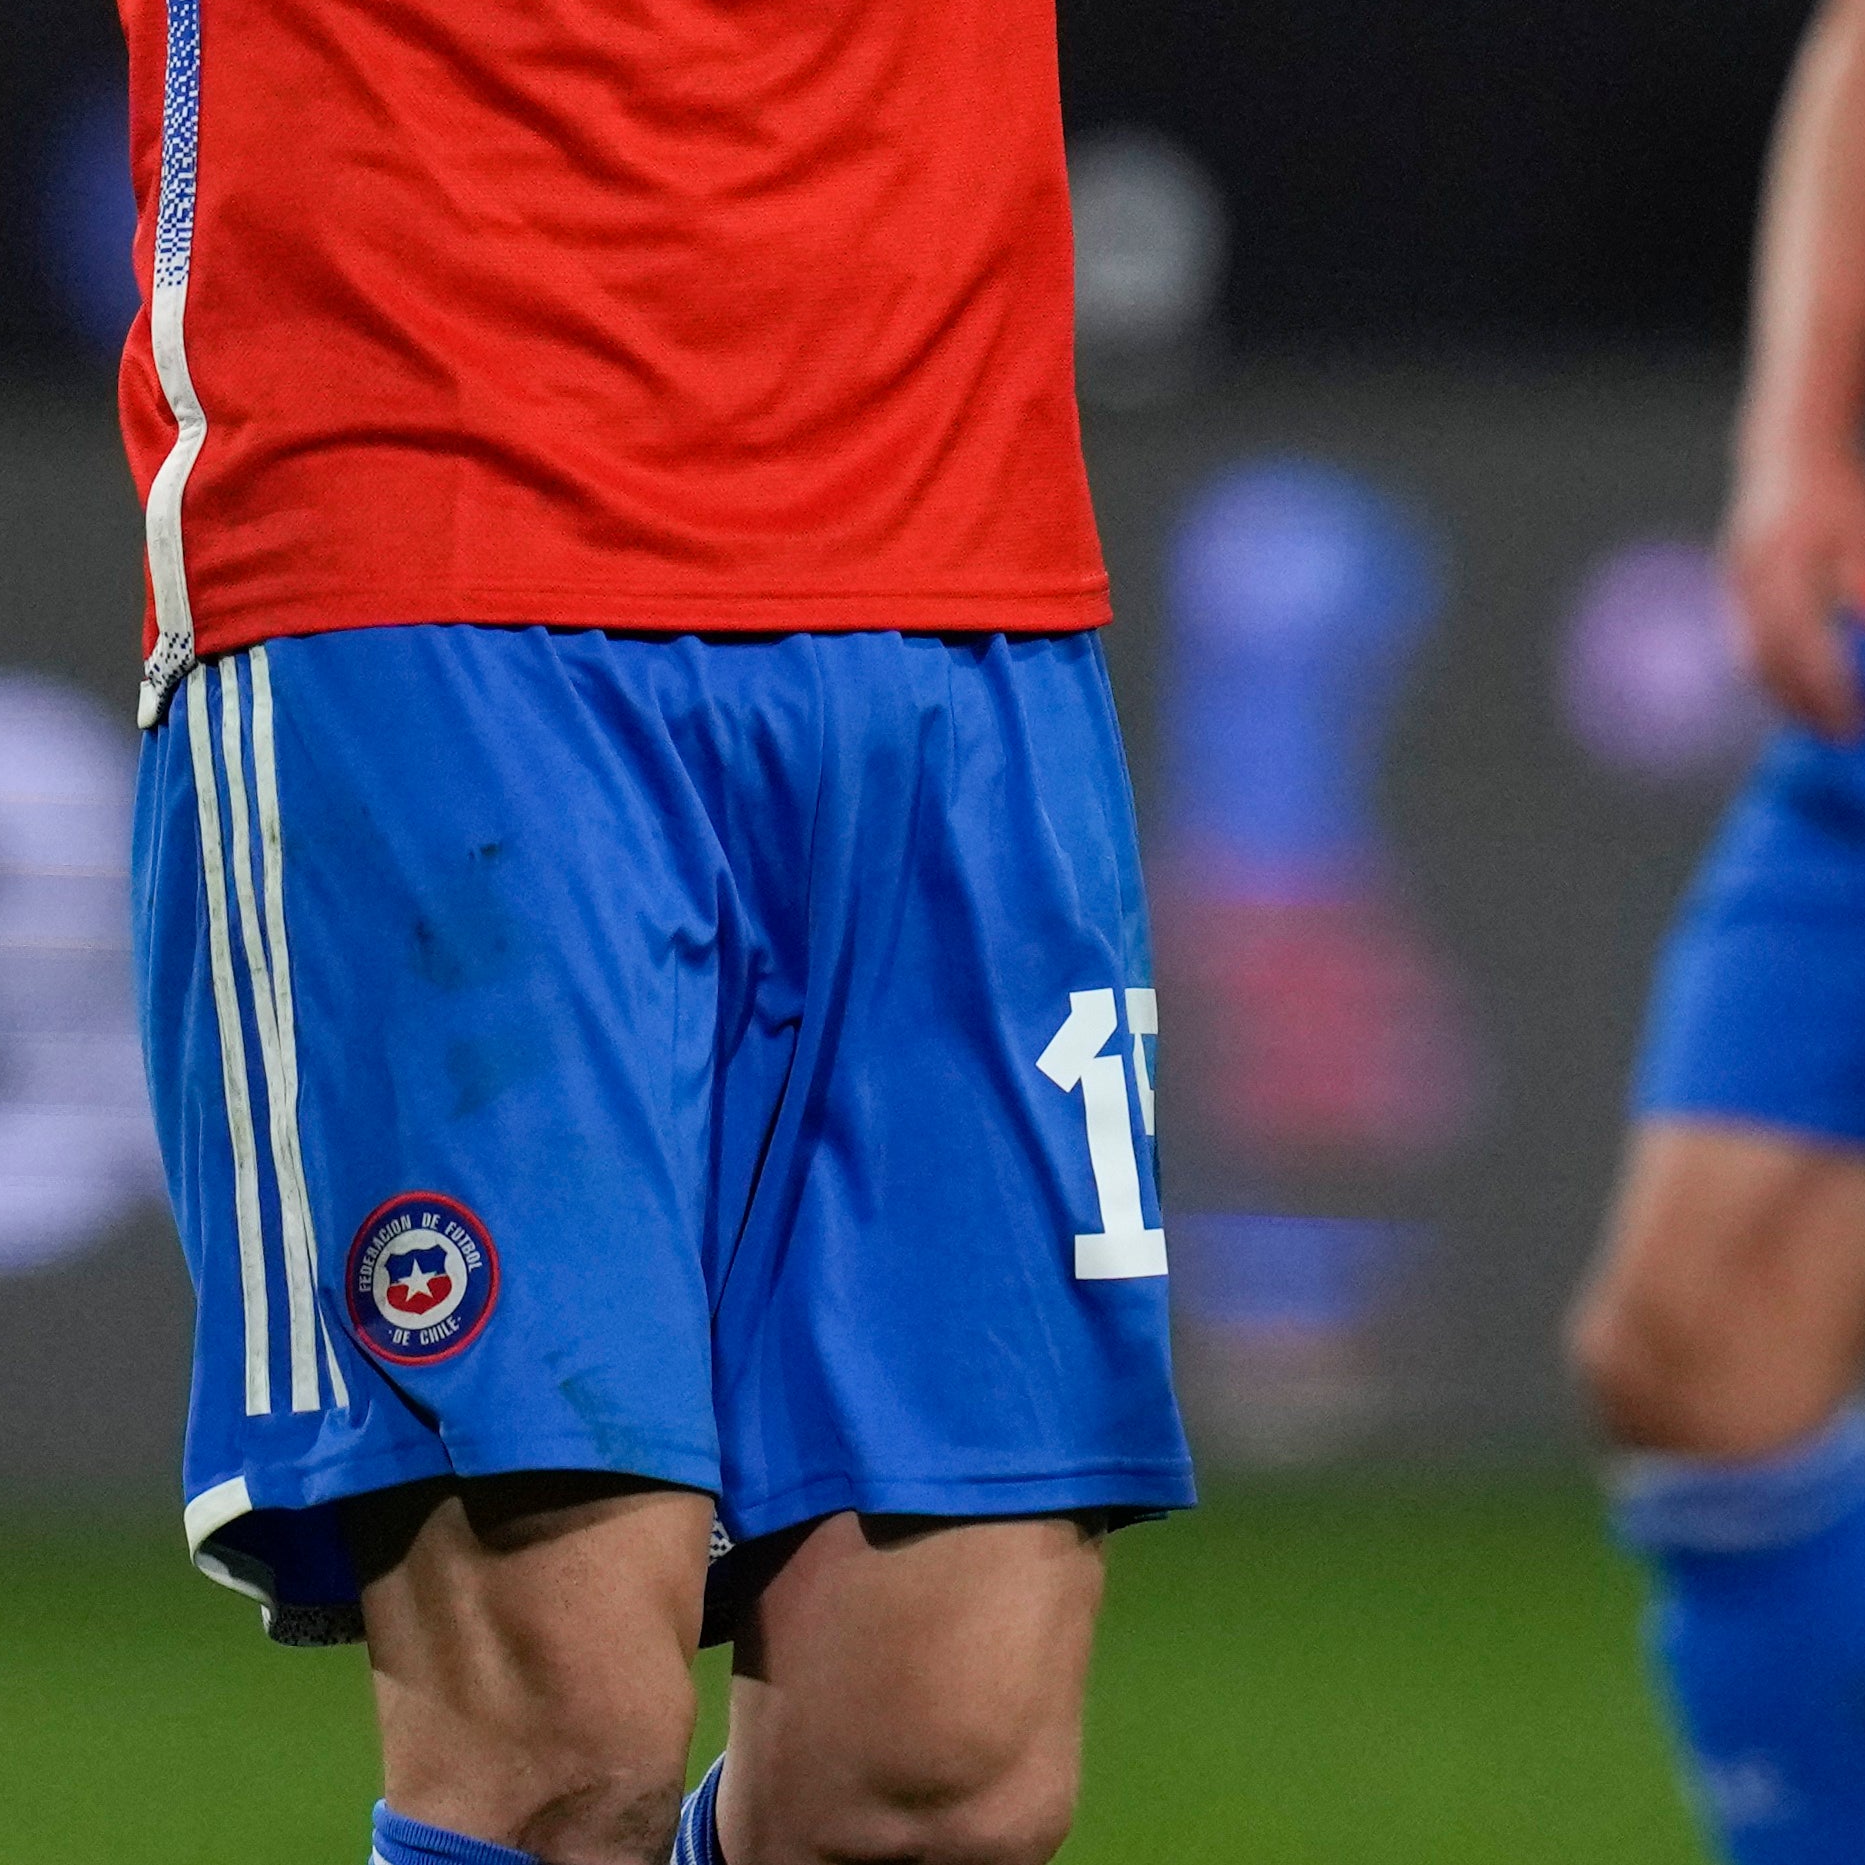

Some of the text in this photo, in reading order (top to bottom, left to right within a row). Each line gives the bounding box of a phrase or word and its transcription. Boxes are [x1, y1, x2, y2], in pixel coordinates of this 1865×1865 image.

[359, 1212, 483, 1293] FEDERACION DE FUTBOL
[392, 1316, 460, 1346] DE CHILE
